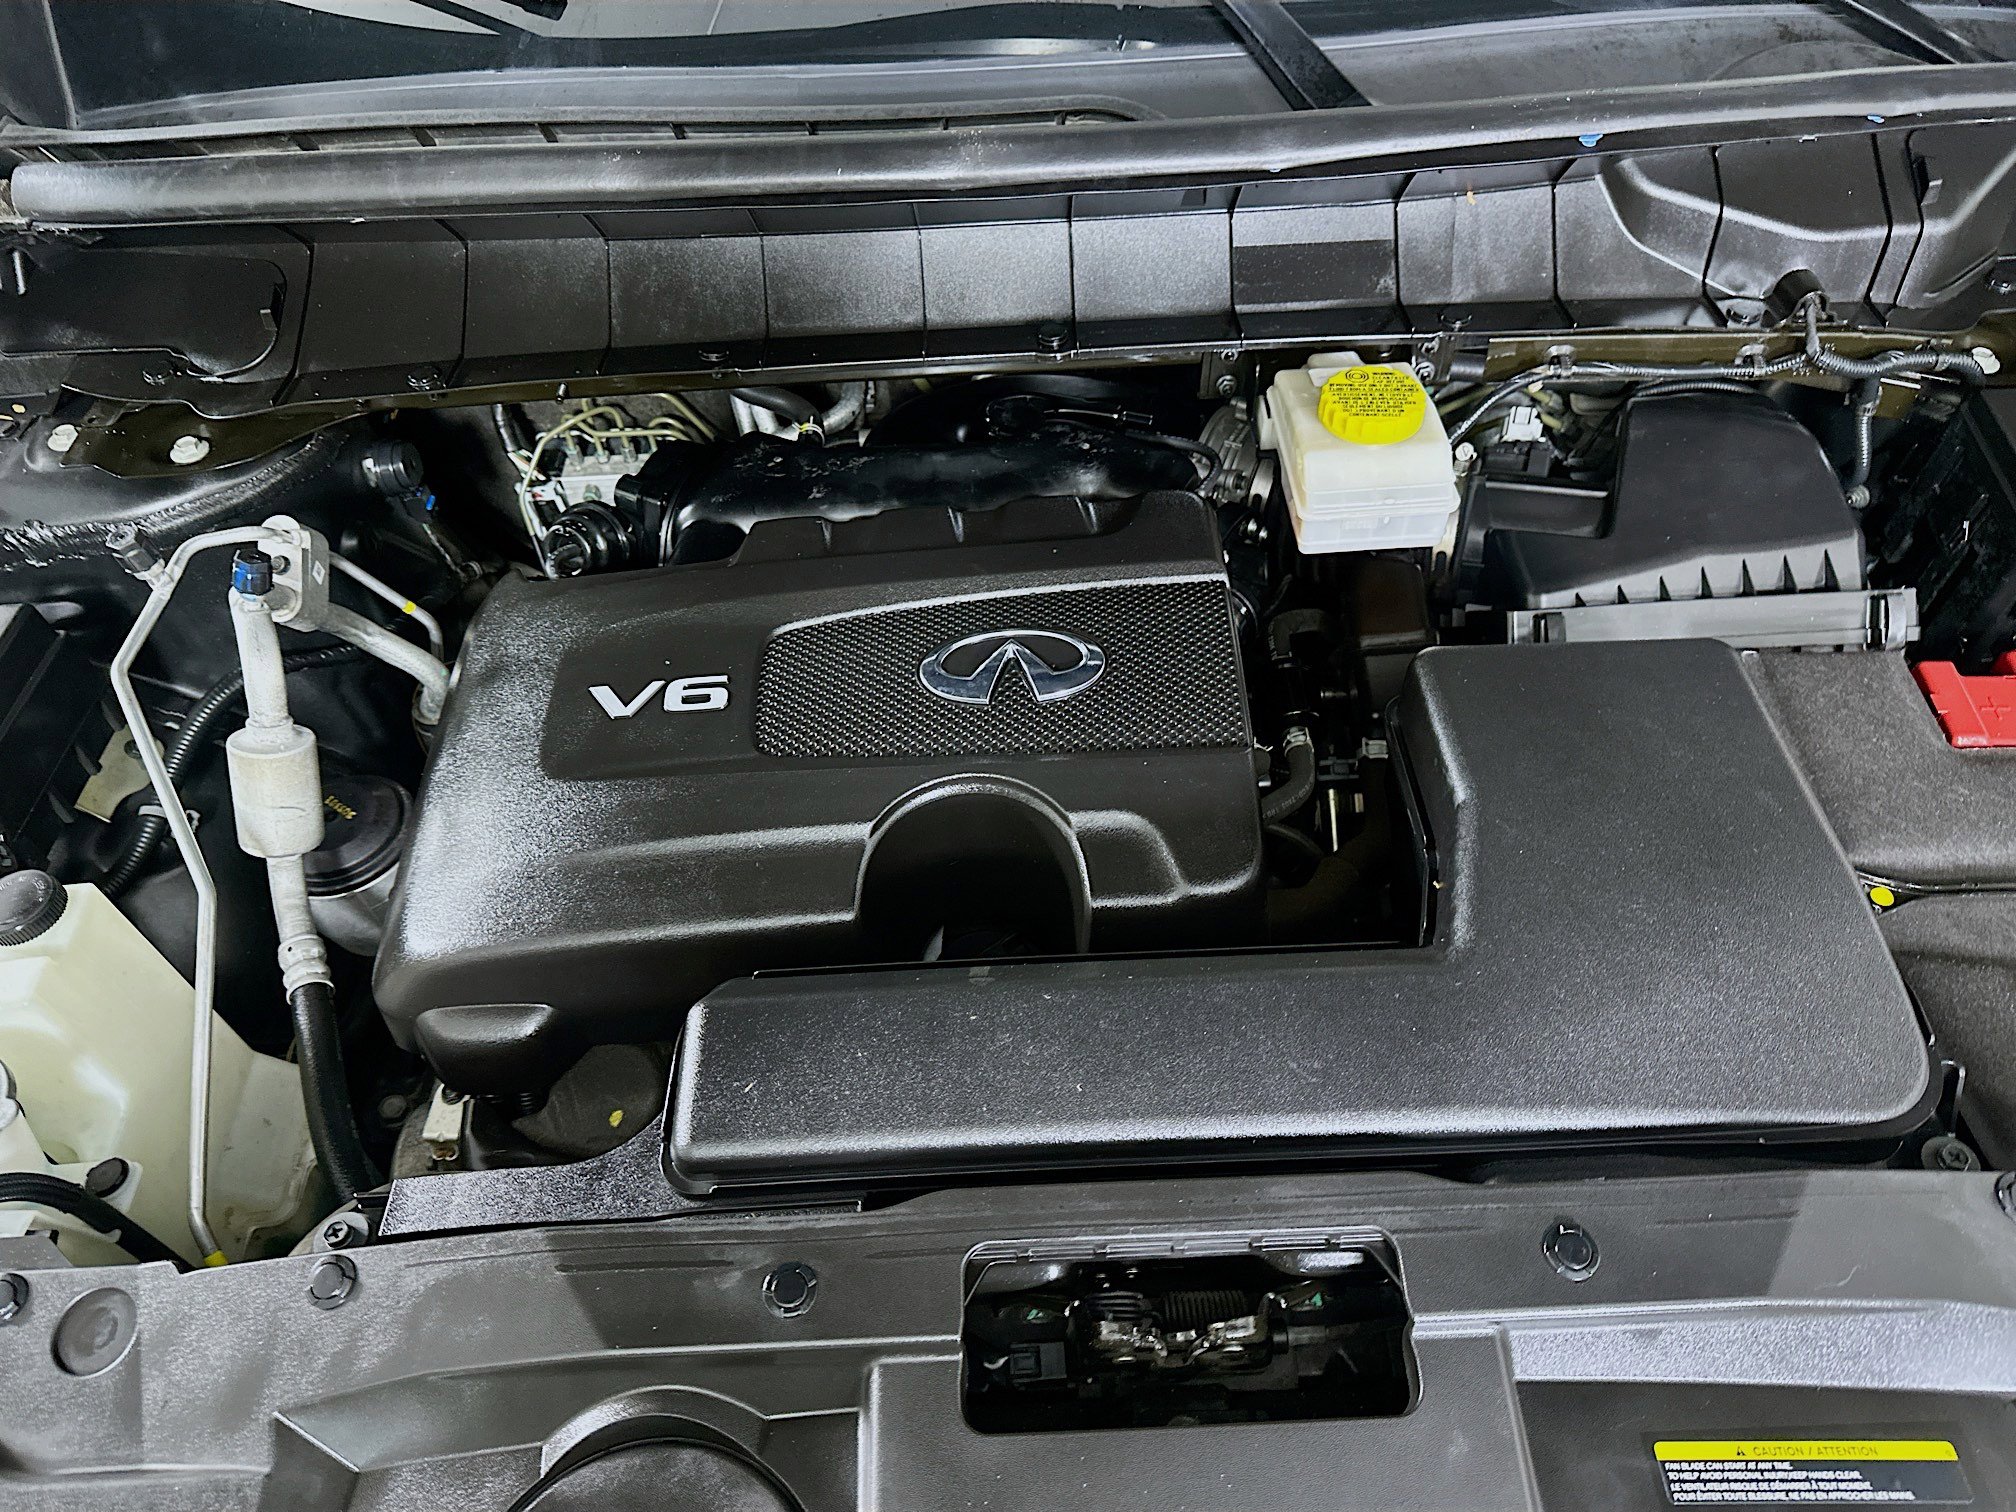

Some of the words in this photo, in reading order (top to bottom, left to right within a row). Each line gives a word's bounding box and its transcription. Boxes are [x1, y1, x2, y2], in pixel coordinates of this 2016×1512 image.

[588, 675, 729, 720] V6
[1752, 1446, 1804, 1456] CAUTION
[1817, 1446, 1879, 1456] ATTENTION
